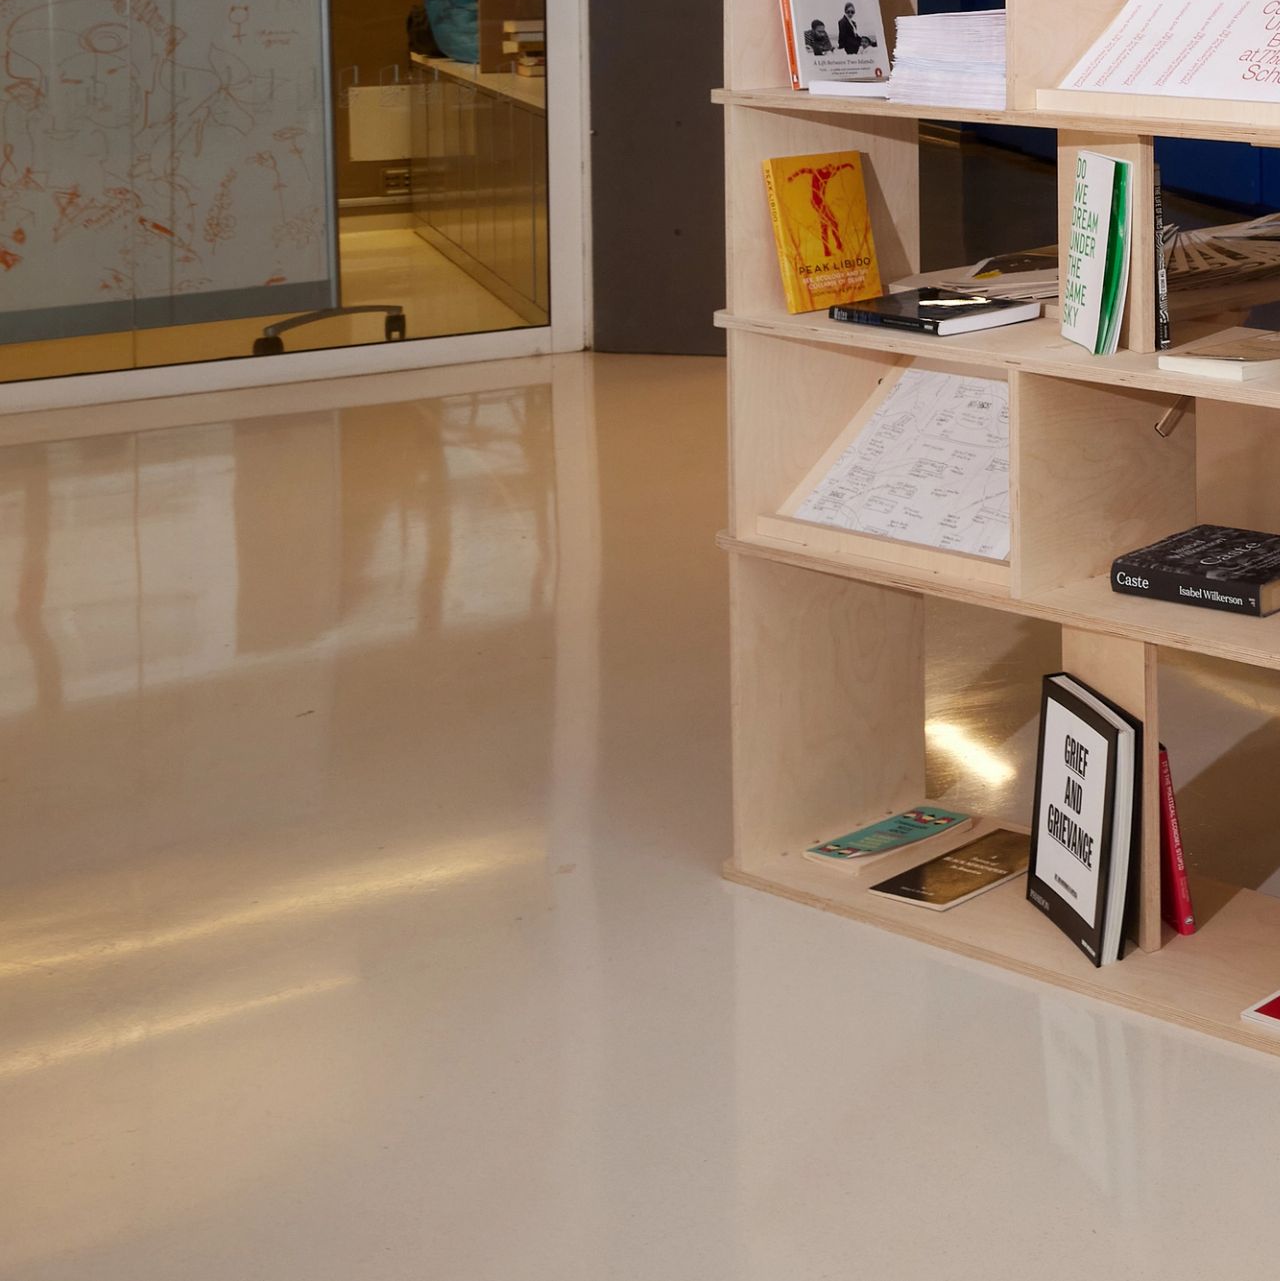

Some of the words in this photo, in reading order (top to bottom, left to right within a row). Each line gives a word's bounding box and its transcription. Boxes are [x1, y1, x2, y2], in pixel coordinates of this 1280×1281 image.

[1239, 49, 1257, 62] at
[1076, 157, 1087, 180] DO
[1075, 184, 1088, 205] WE
[1072, 205, 1099, 232] DREAM
[1069, 231, 1095, 259] UNDER
[799, 261, 830, 274] PEAK
[834, 257, 871, 270] LIBIDO
[1068, 254, 1081, 279] THE
[1065, 278, 1086, 306] SAME
[1063, 303, 1079, 328] SKY
[1200, 542, 1262, 565] Caste
[1117, 572, 1149, 589] Caste
[1180, 585, 1202, 598] Isabel
[1203, 588, 1243, 606] Wilkerson
[1064, 734, 1089, 777] GRIEF
[1064, 776, 1083, 815] AND
[1047, 803, 1094, 869] GRIEVANCE
[1167, 788, 1175, 817] POLITICAL
[1176, 849, 1184, 871] STUPID
